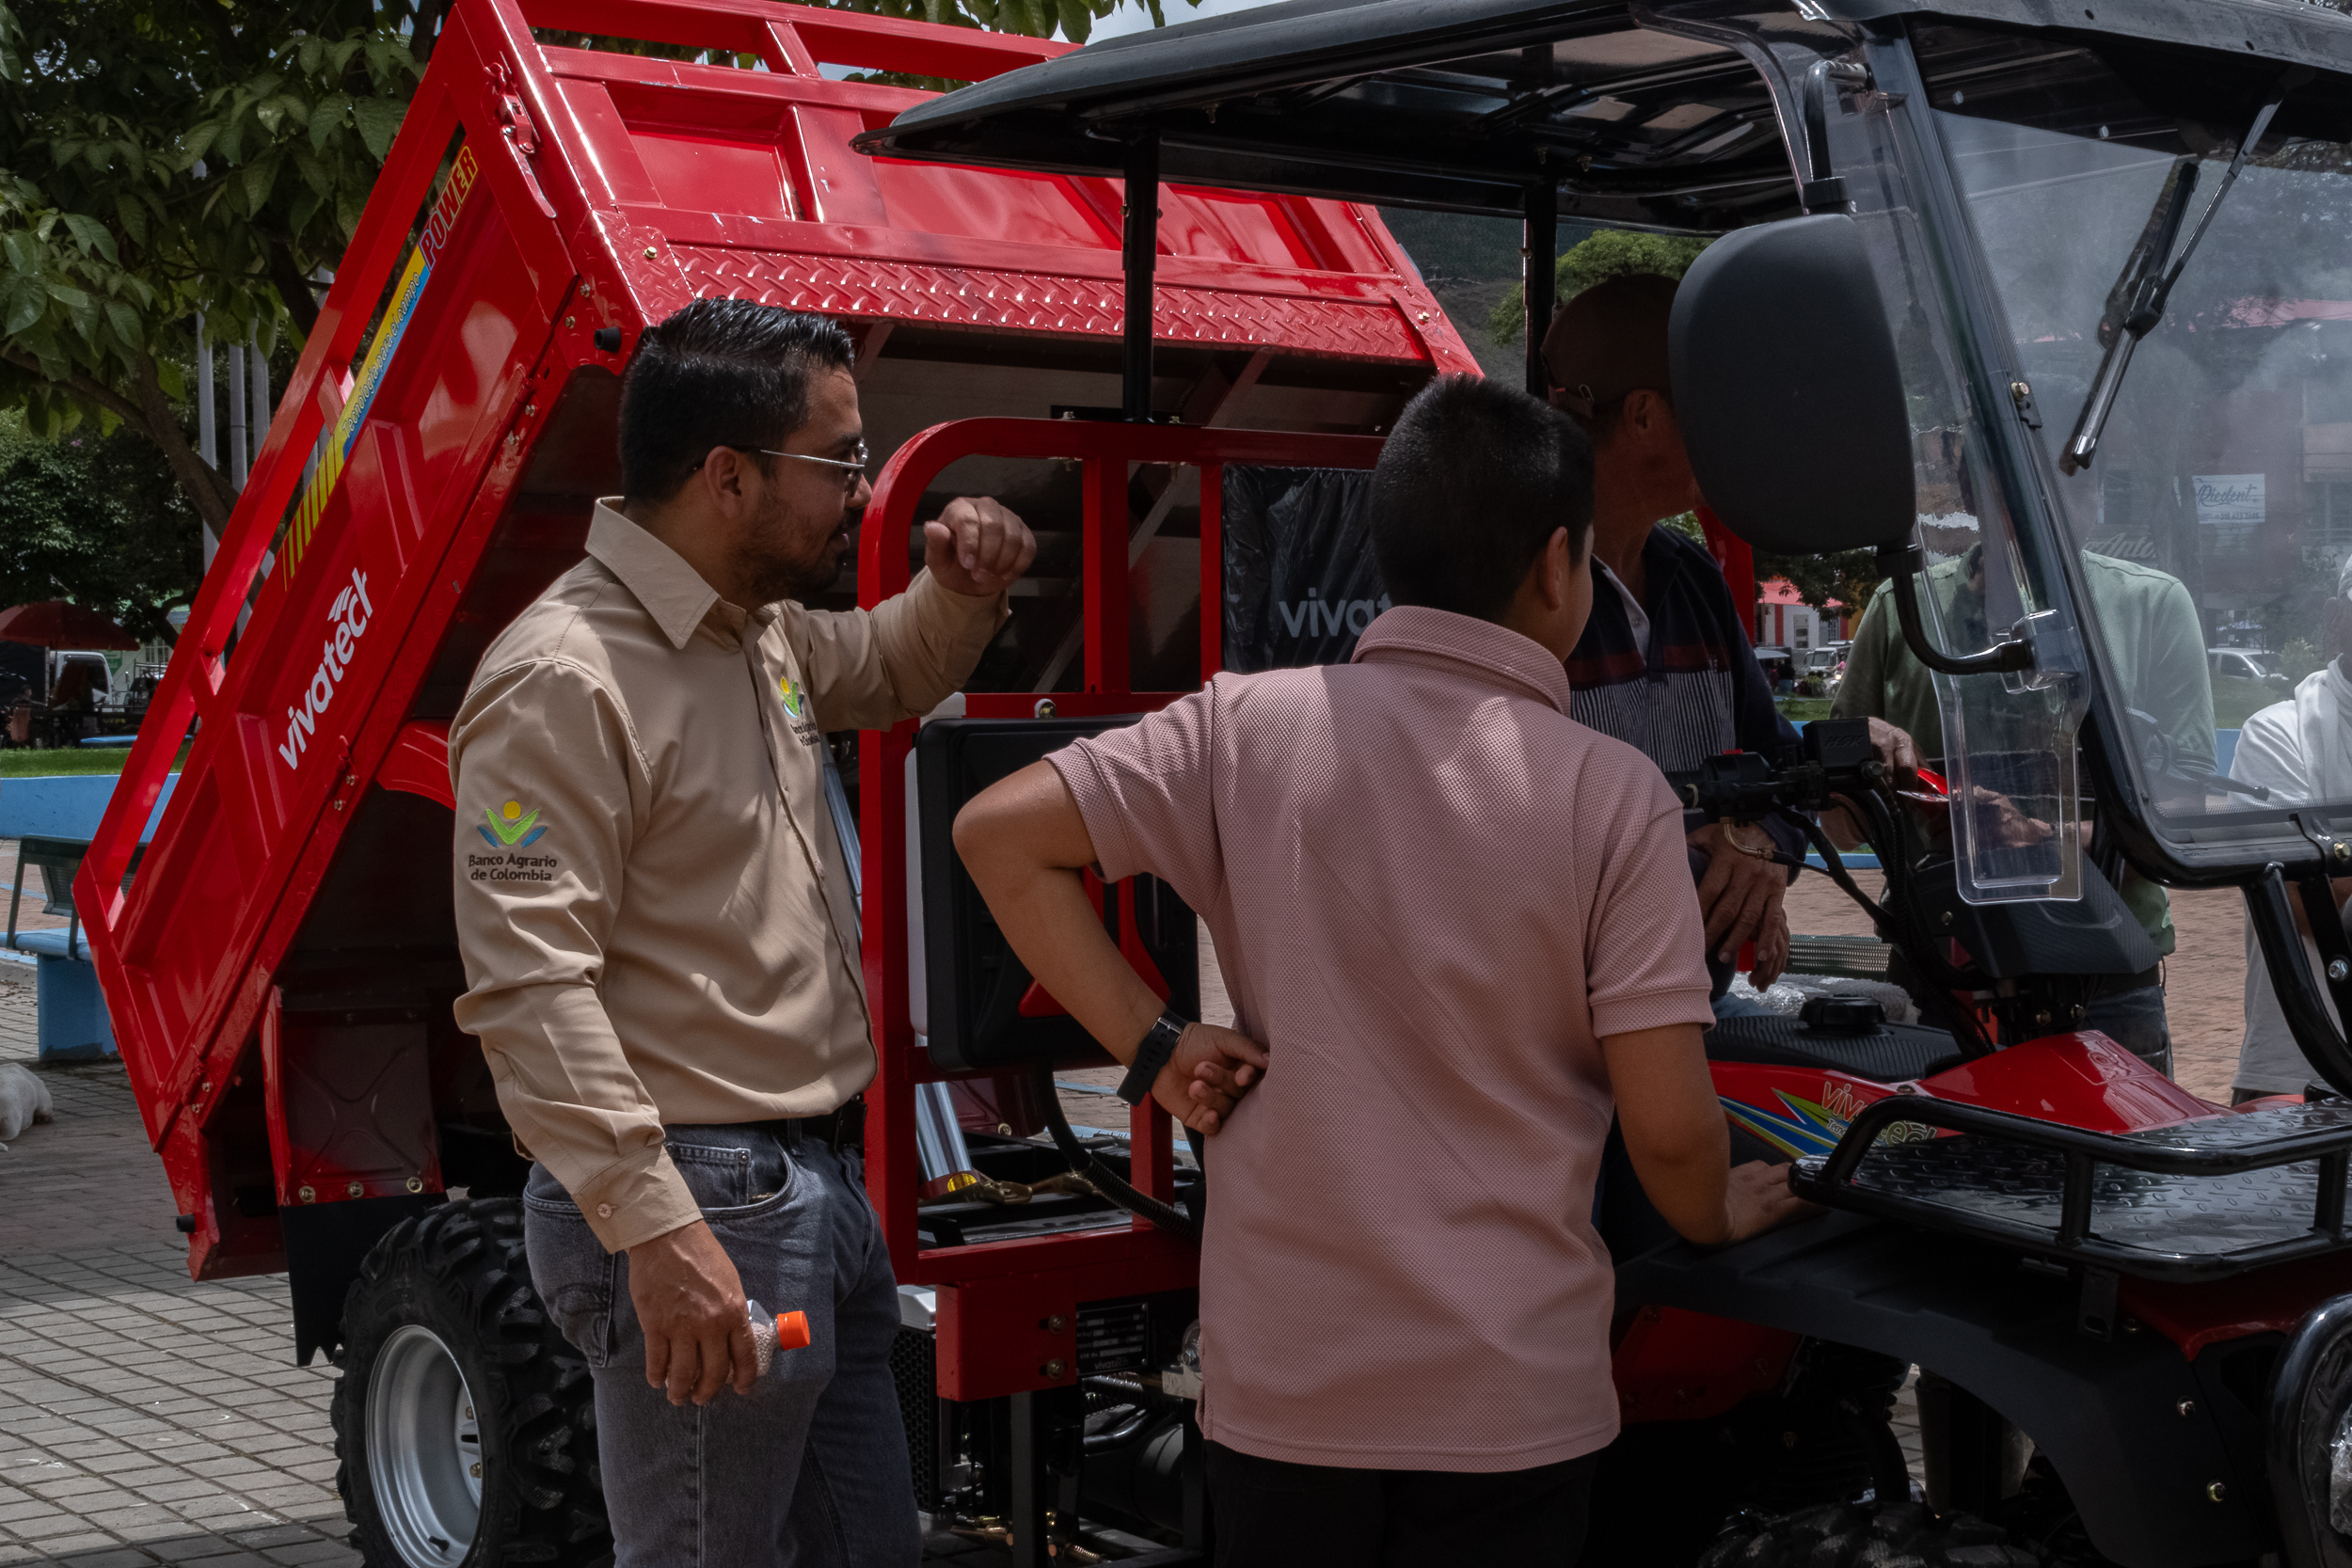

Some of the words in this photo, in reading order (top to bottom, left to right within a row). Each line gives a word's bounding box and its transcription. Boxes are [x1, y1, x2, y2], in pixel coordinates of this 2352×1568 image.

[419, 146, 478, 271] POWER
[375, 333, 394, 372] para
[390, 314, 400, 337] el
[396, 272, 420, 322] campo
[1278, 587, 1392, 639] vivat
[469, 854, 503, 867] Banco
[506, 853, 557, 868] Agrario
[470, 868, 487, 880] de
[490, 868, 552, 881] Colombia
